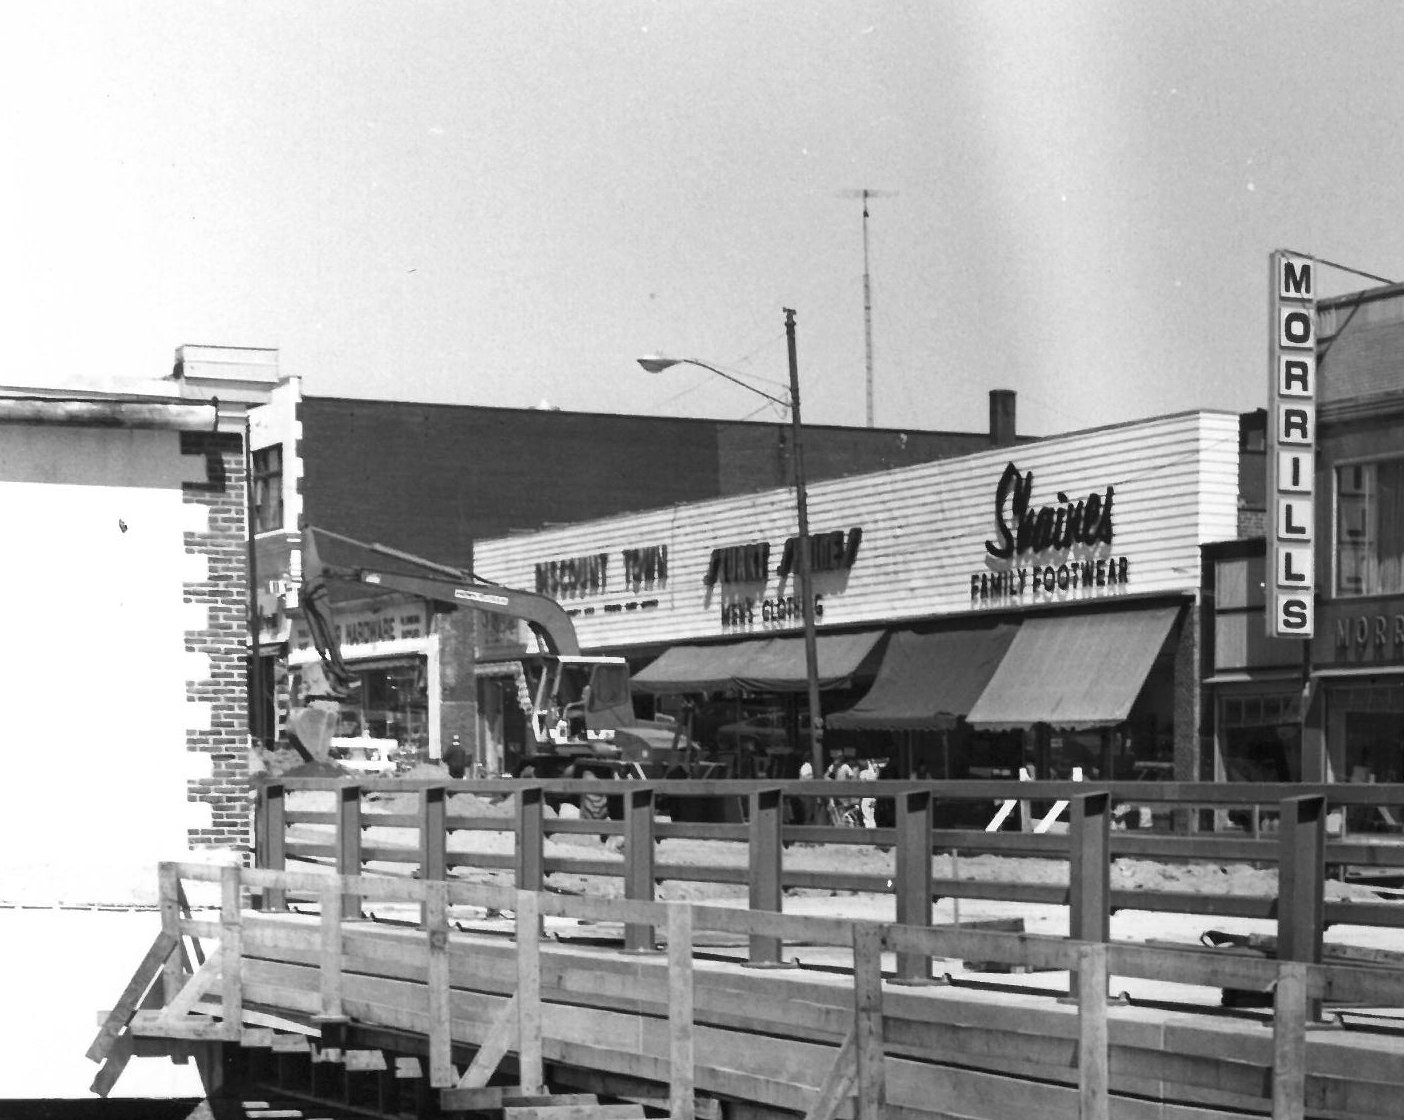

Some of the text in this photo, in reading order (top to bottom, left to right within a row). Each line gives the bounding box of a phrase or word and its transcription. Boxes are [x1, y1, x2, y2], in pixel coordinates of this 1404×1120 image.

[1281, 262, 1312, 629] MORRILLS
[971, 556, 1128, 600] FAMILY FOOTWEAR
[762, 594, 824, 622] CLOTHG
